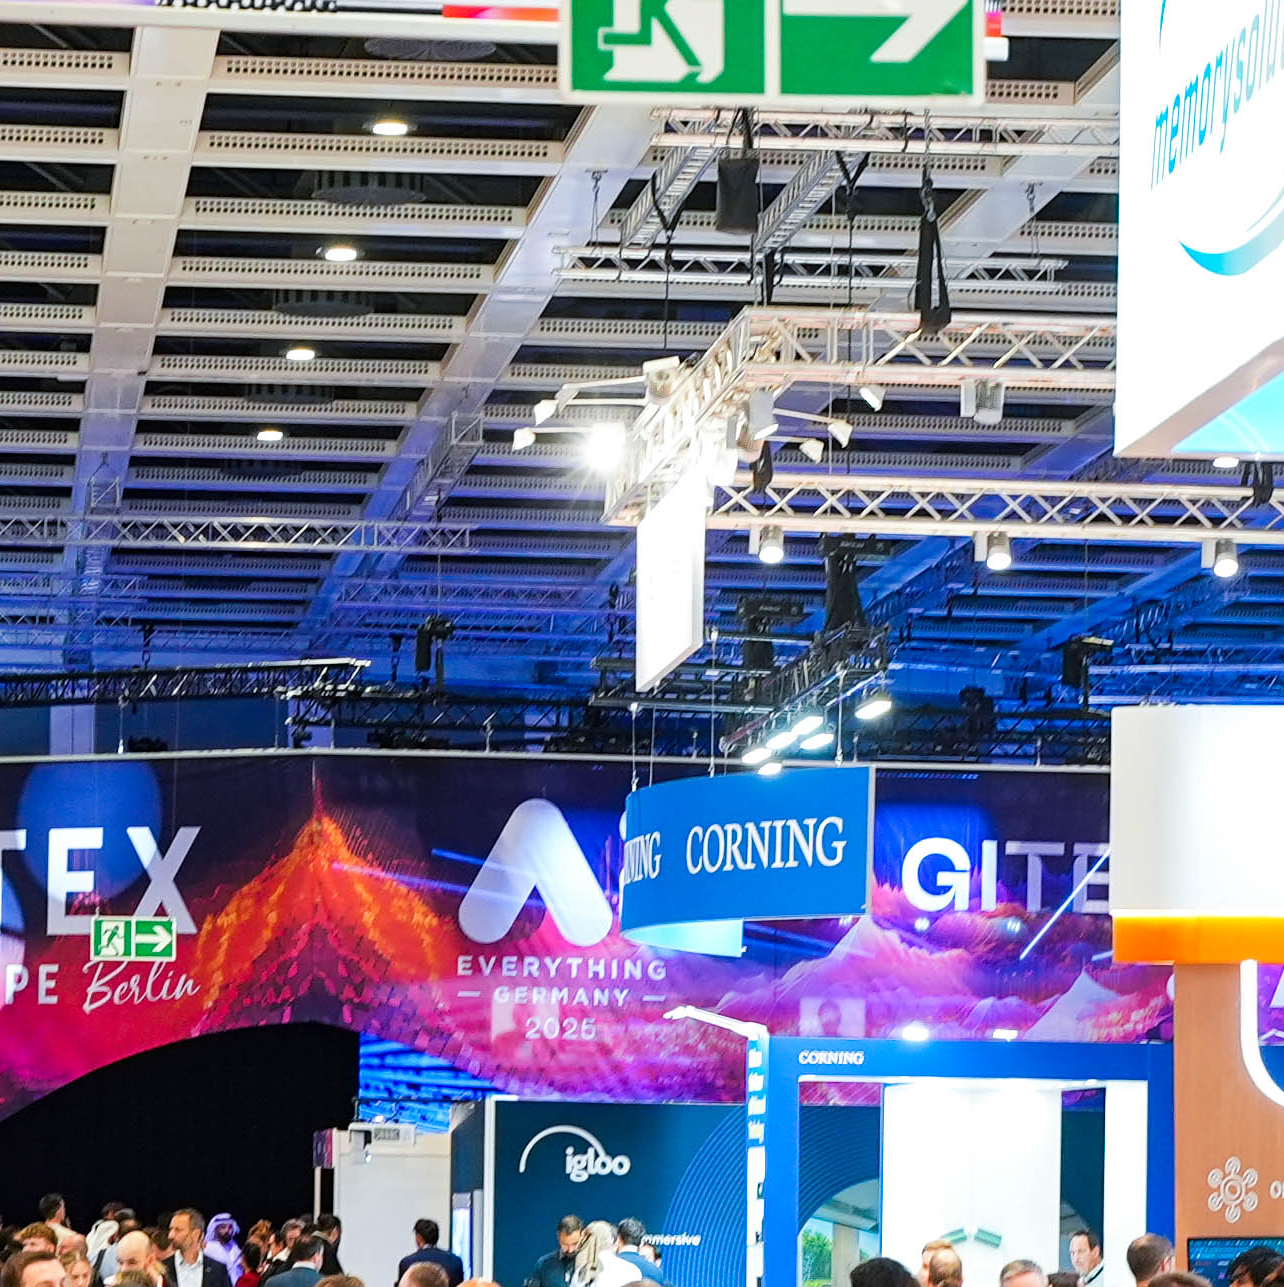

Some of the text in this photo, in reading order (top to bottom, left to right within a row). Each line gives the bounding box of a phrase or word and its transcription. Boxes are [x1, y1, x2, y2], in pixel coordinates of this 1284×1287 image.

[685, 816, 847, 874] CORNING
[457, 956, 667, 981] EVERYTHING
[82, 960, 202, 1015] Berlin
[493, 986, 630, 1006] GERMANY
[798, 1051, 865, 1065] CORNING
[565, 1146, 632, 1182] igloo
[640, 1232, 702, 1247] mmersive
